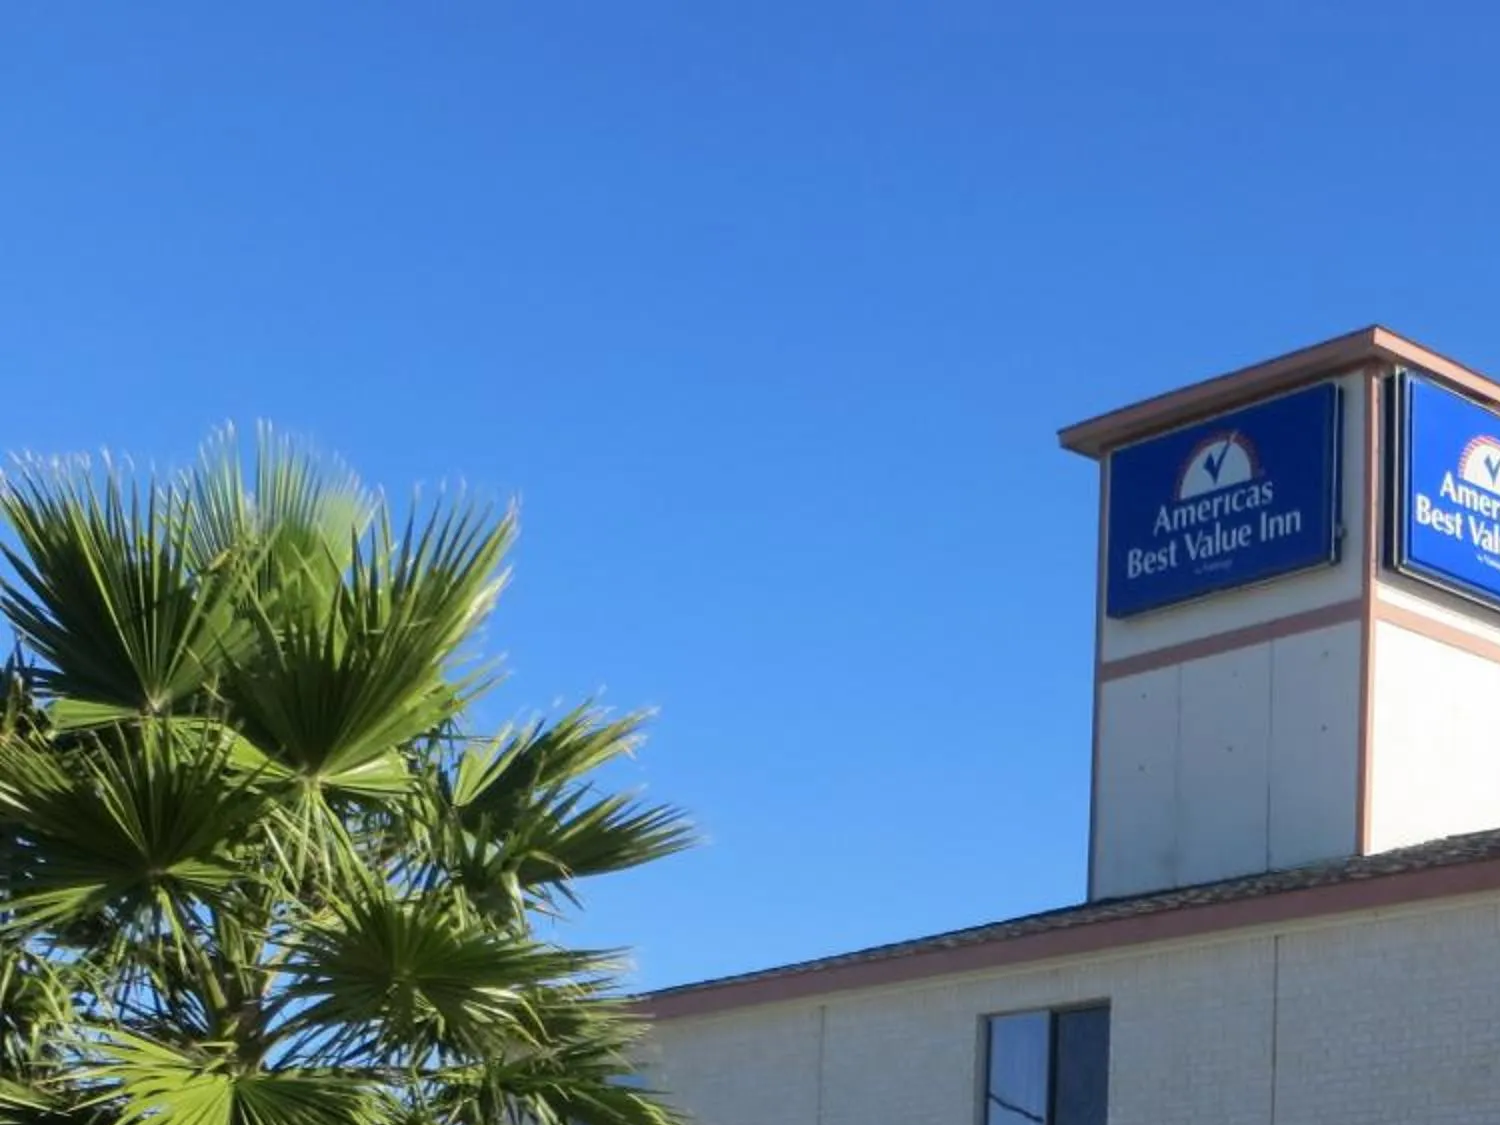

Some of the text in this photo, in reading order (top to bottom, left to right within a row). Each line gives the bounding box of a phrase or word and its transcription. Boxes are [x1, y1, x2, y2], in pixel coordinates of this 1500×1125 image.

[1153, 480, 1274, 537] Americas
[1415, 493, 1463, 541] Best
[1127, 509, 1302, 580] Best Value Inn
